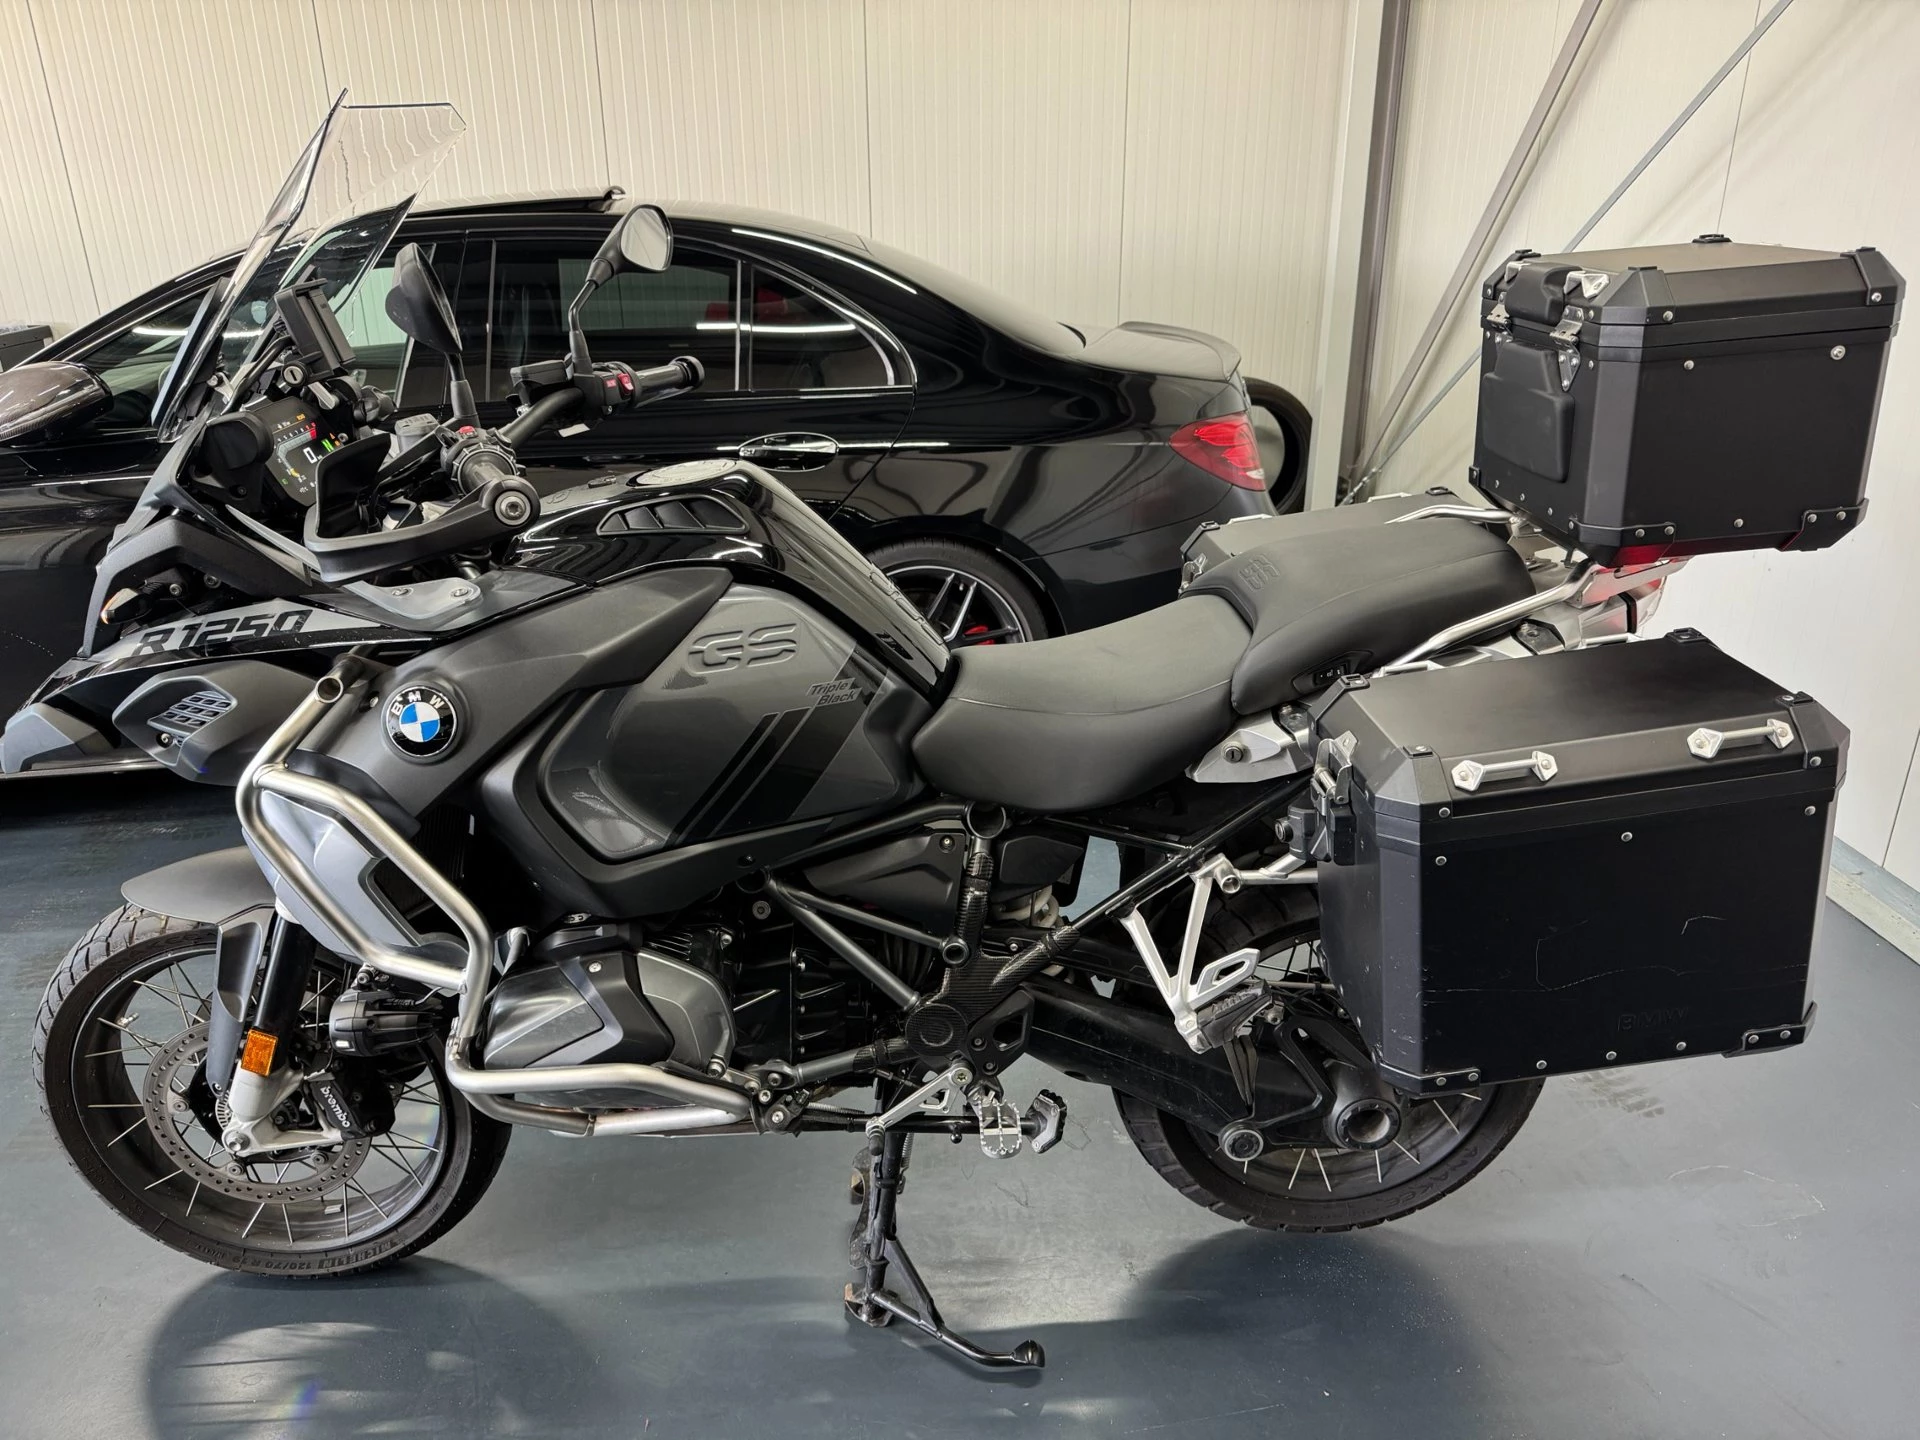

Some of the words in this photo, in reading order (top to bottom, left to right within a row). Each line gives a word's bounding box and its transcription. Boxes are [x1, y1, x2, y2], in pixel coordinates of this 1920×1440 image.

[130, 627, 175, 657] R
[179, 609, 313, 650] 1250
[688, 623, 797, 675] GS
[810, 681, 849, 697] Triple
[817, 690, 857, 706] Black
[391, 690, 445, 716] BMW
[1617, 1005, 1690, 1032] BMW
[320, 1085, 350, 1128] brembo
[265, 1258, 312, 1270] 120/70
[318, 1240, 392, 1270] MICHELIN
